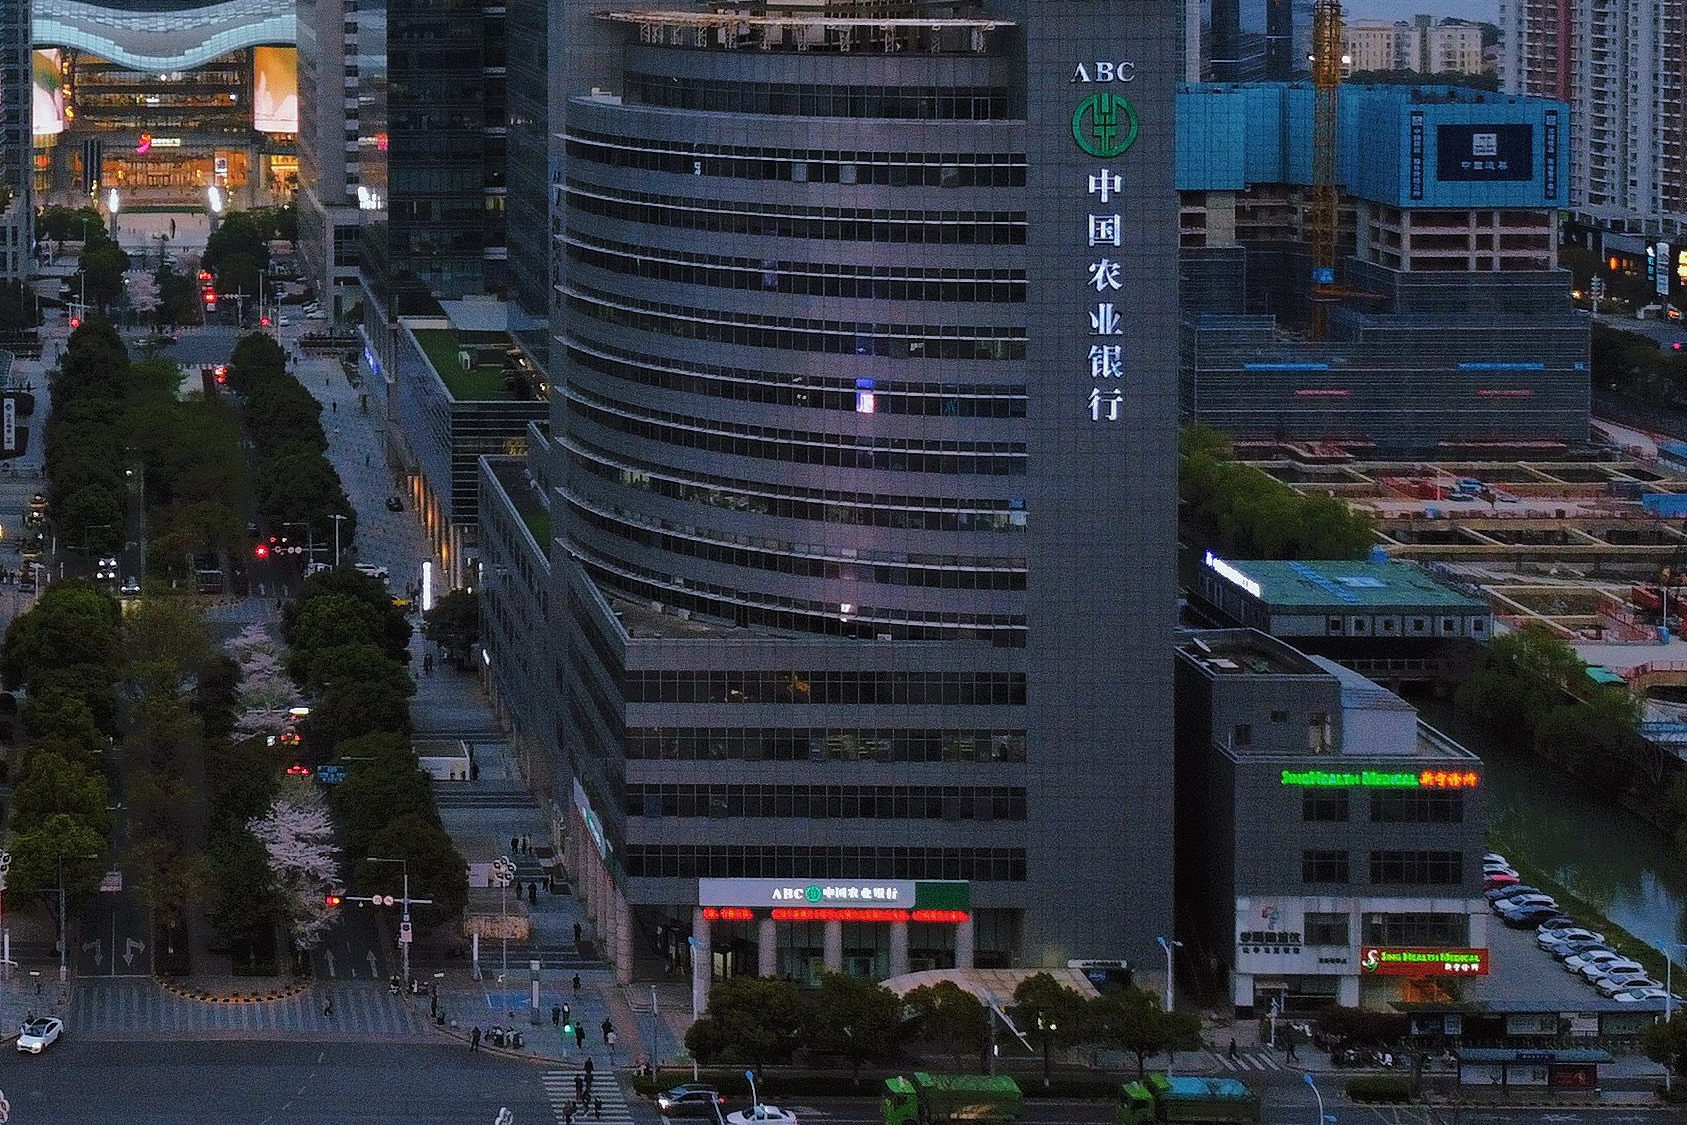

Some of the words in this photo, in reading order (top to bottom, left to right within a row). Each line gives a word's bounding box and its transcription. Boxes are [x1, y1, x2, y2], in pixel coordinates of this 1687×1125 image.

[1071, 62, 1135, 83] ABC
[1086, 168, 1123, 421] 中国农业银行
[772, 888, 804, 900] ABC
